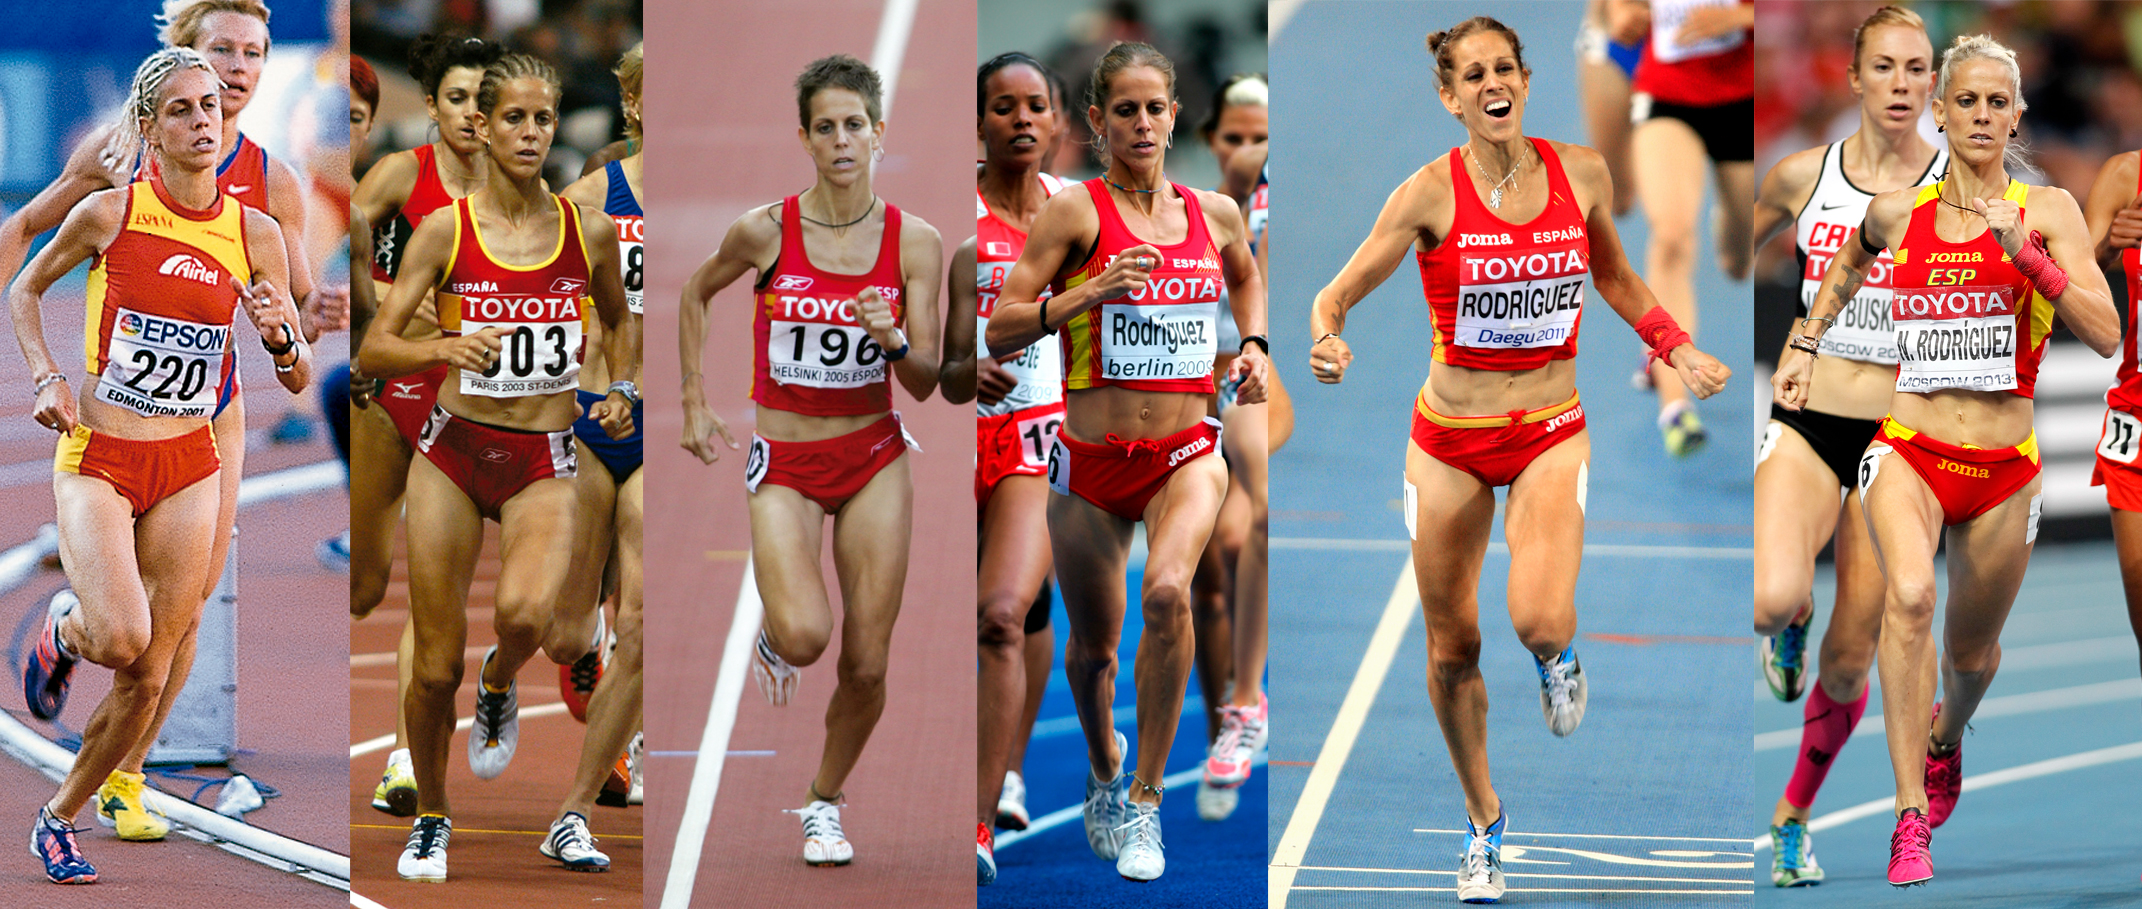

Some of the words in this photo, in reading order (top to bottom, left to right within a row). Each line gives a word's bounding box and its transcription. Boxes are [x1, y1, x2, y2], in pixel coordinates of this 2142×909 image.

[1533, 226, 1584, 244] ESPAÑA
[173, 261, 219, 286] Airtel
[1173, 257, 1220, 270] ESPAÑA
[1466, 249, 1585, 281] TOYOTA
[452, 280, 498, 293] ESPAÑA
[1127, 277, 1217, 301] OYOTA
[1926, 268, 1977, 287] ESP
[465, 296, 578, 319] TOYOTA
[781, 296, 857, 323] TOYO
[1462, 281, 1583, 320] RODRÍGUEZ
[1895, 291, 2008, 316] TOYOTA
[1845, 297, 1895, 332] BUSK
[143, 318, 227, 351] EPSON
[790, 326, 882, 367] 196
[1112, 313, 1207, 355] Rodríguez
[1478, 329, 1537, 347] Daegu
[1536, 327, 1566, 342] 2011
[1917, 320, 2013, 362] RODRÍGUEZ
[481, 325, 568, 378] 03
[1011, 342, 1041, 370] ete
[1819, 338, 1873, 356] OSCOW
[1877, 346, 1896, 359] 20
[124, 349, 208, 402] 220
[774, 365, 822, 382] HELSINKI
[824, 371, 849, 383] 2005
[1108, 358, 1174, 377] berlin
[471, 380, 499, 391] PARIS
[502, 383, 525, 392] 2003
[527, 377, 571, 392] ST-DENIS
[1899, 376, 1968, 388] MOSCOW
[1972, 373, 2012, 388] 2013
[107, 388, 177, 417] EDMONTON
[178, 407, 205, 416] 2001
[2107, 416, 2133, 456] 11
